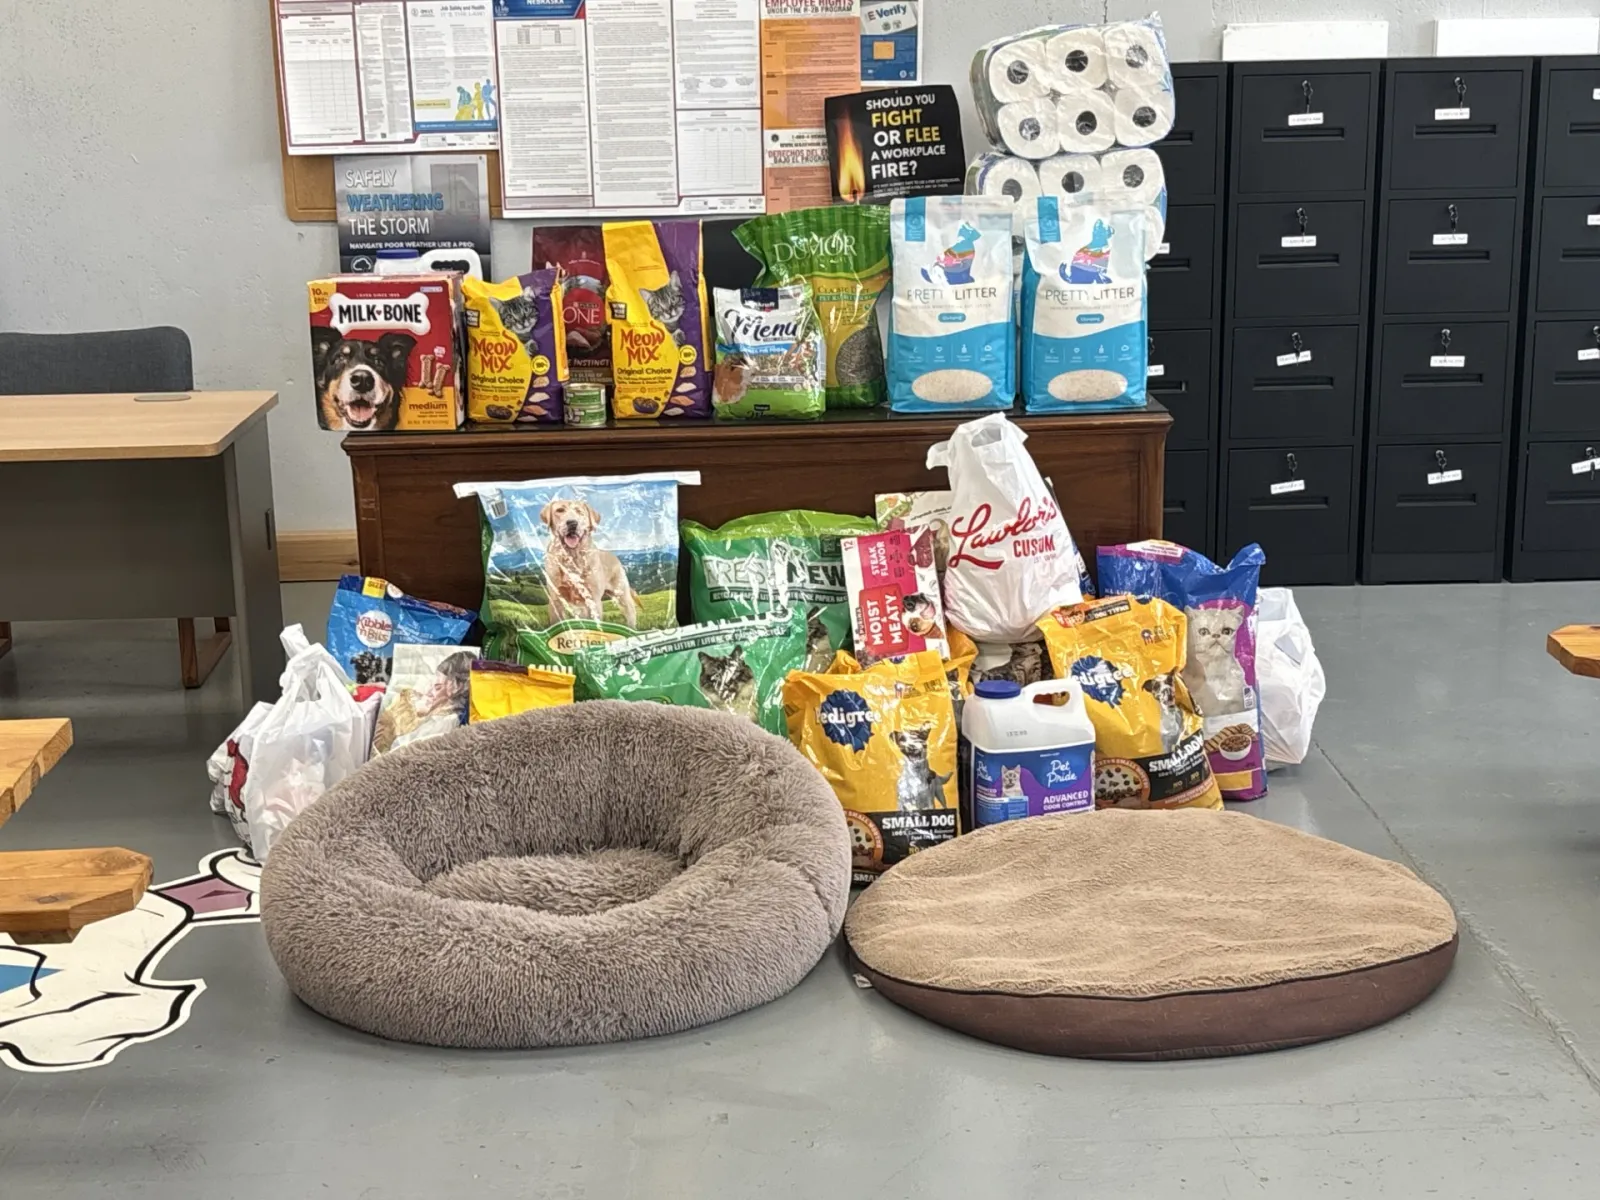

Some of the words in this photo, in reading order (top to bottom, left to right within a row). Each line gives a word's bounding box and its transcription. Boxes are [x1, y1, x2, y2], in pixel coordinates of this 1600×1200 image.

[865, 96, 913, 110] SHOULD
[915, 94, 936, 105] YOU
[871, 109, 923, 128] FIGHT
[873, 130, 902, 147] OR
[905, 126, 941, 143] FLEE
[870, 151, 880, 161] A
[881, 145, 946, 160] WORKPLACE
[345, 169, 397, 188] SAFELY
[871, 160, 918, 180] FIRE?
[346, 192, 444, 212] WEATHERING
[348, 218, 377, 236] THE
[380, 217, 430, 236] STORM
[953, 287, 997, 301] LITTER
[1045, 288, 1090, 305] PRETTY
[563, 306, 600, 325] ONE
[472, 330, 518, 357] Meow
[620, 321, 665, 350] Meow
[471, 373, 496, 384] Original
[497, 375, 525, 383] Choice
[617, 367, 643, 376] Original
[645, 367, 672, 375] Choice
[408, 401, 448, 410] medium
[948, 496, 1057, 570] Lawlor's
[843, 541, 854, 551] 12
[868, 546, 881, 576] STEAK
[879, 541, 889, 577] FLAVOR
[866, 600, 884, 646] MOIST
[885, 595, 903, 645] MEATY
[1050, 759, 1070, 773] Pet
[1046, 771, 1078, 788] Pride
[1043, 790, 1089, 805] ADVANCED
[1043, 803, 1061, 811] ODOR
[1062, 799, 1088, 809] CONTROL
[882, 816, 930, 830] SMALL
[931, 814, 955, 827] DOG
